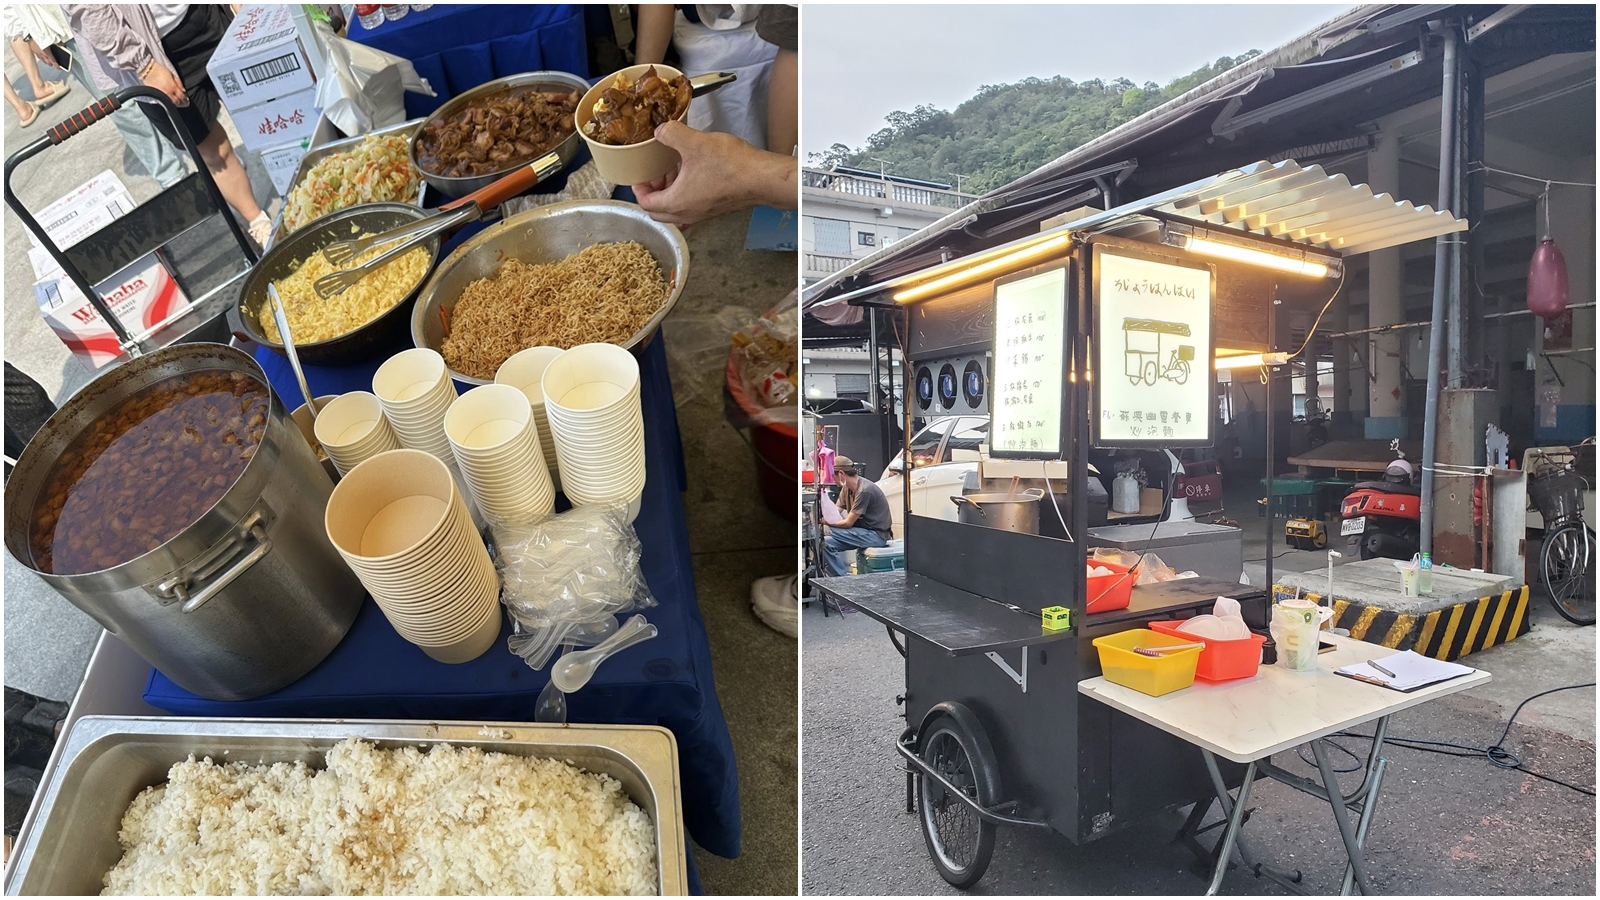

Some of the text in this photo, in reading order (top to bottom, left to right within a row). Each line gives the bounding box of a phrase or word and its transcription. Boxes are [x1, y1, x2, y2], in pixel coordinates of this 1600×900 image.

[258, 109, 305, 134] 娃哈哈
[72, 279, 145, 320] Whaha
